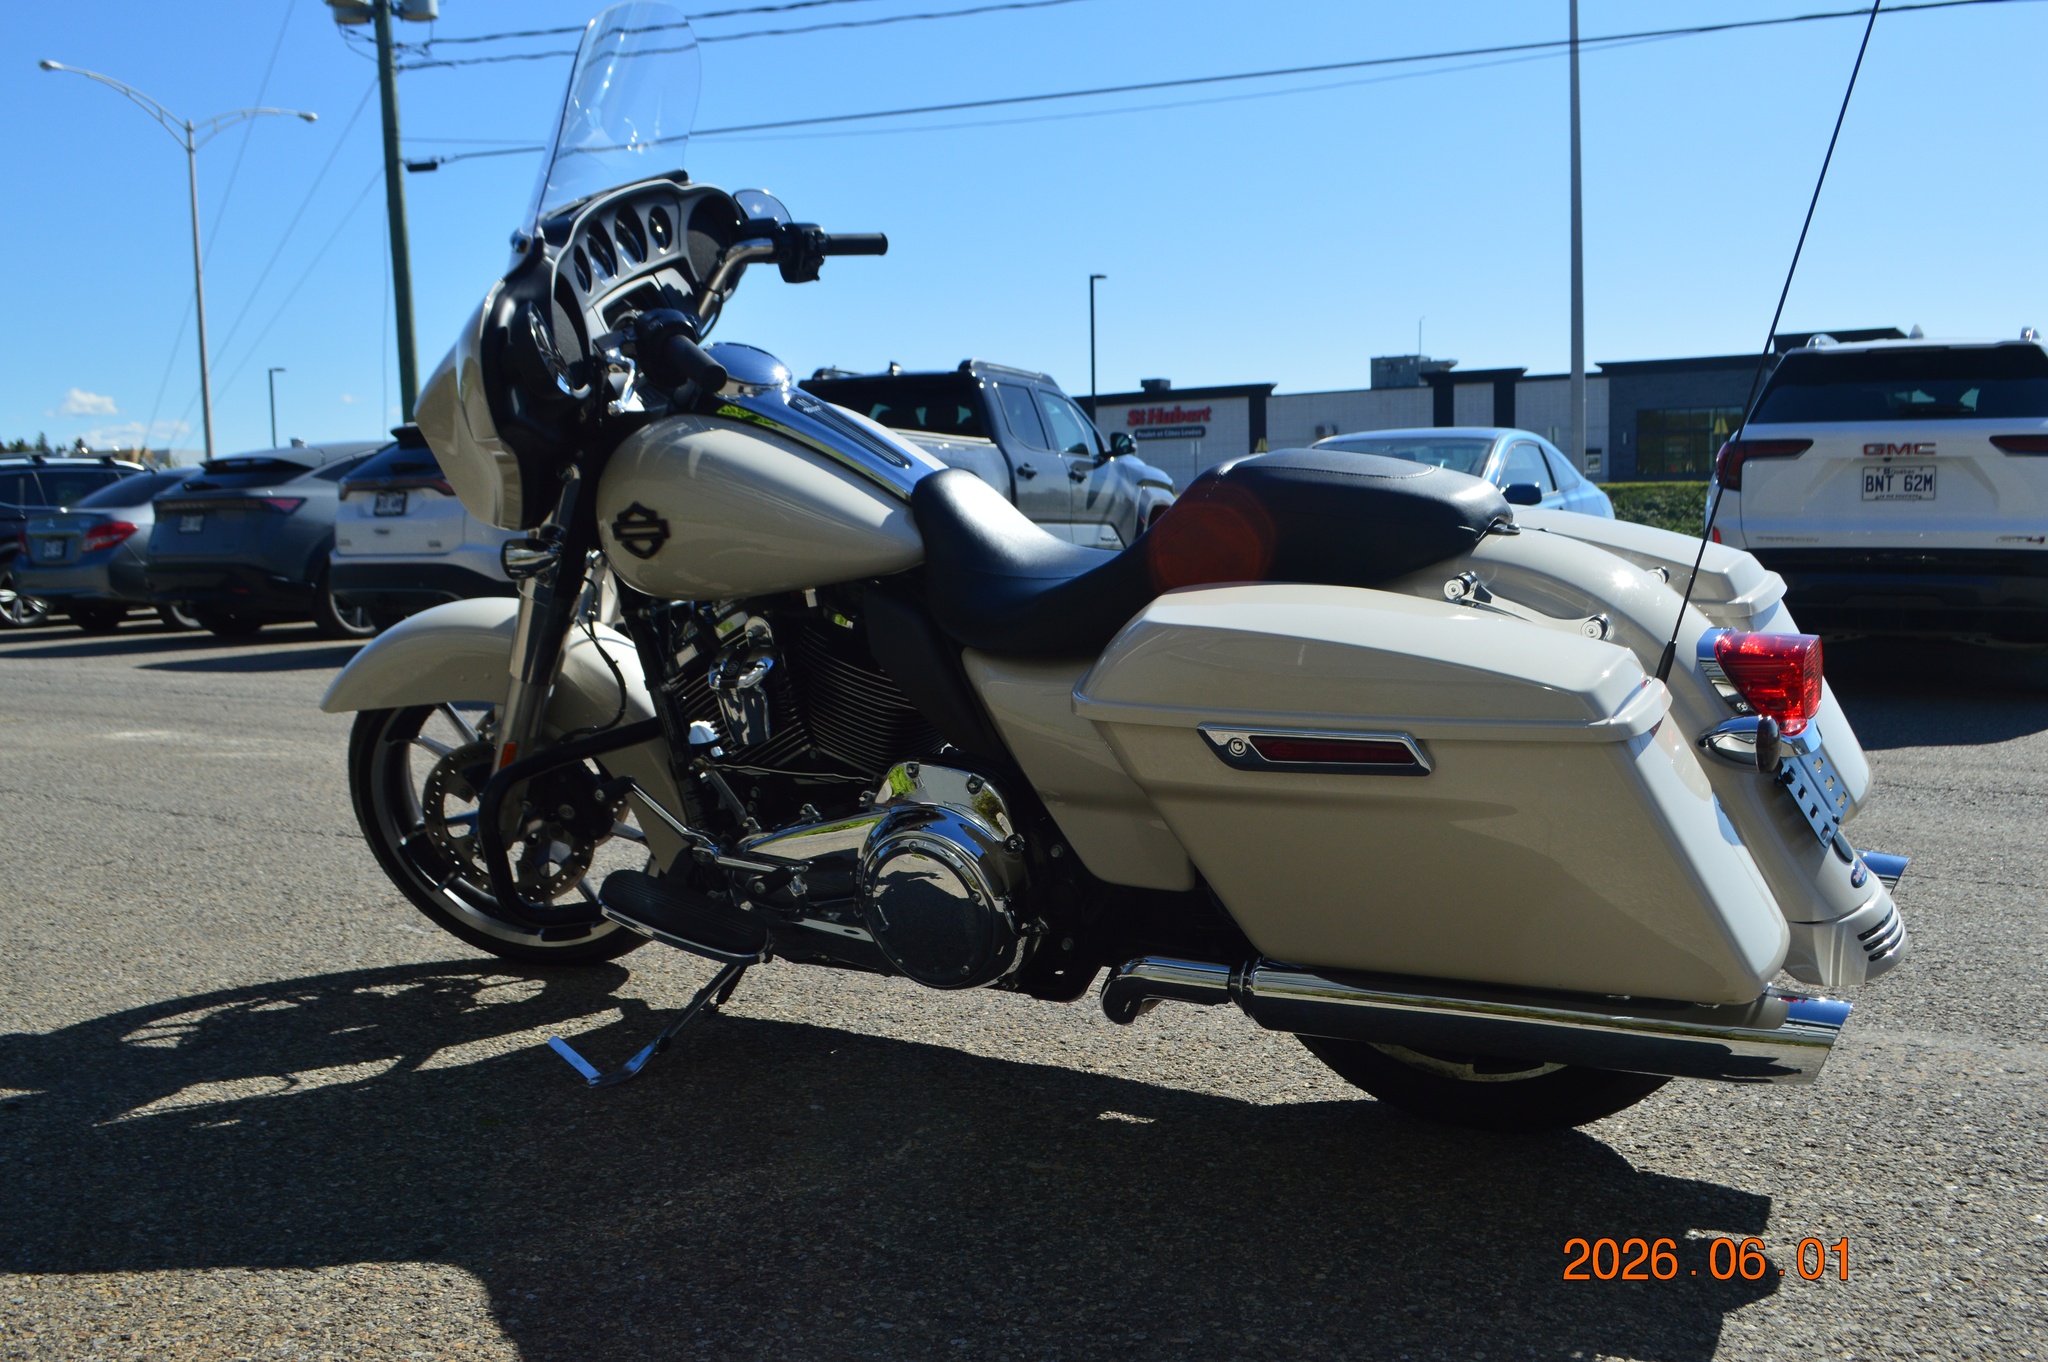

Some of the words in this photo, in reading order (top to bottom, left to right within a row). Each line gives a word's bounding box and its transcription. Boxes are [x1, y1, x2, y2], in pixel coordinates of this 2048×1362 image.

[1127, 409, 1145, 426] St
[1147, 406, 1211, 424] Hubert
[1863, 442, 1936, 456] GMC
[1865, 475, 1893, 493] BNT
[1904, 474, 1933, 492] 62M
